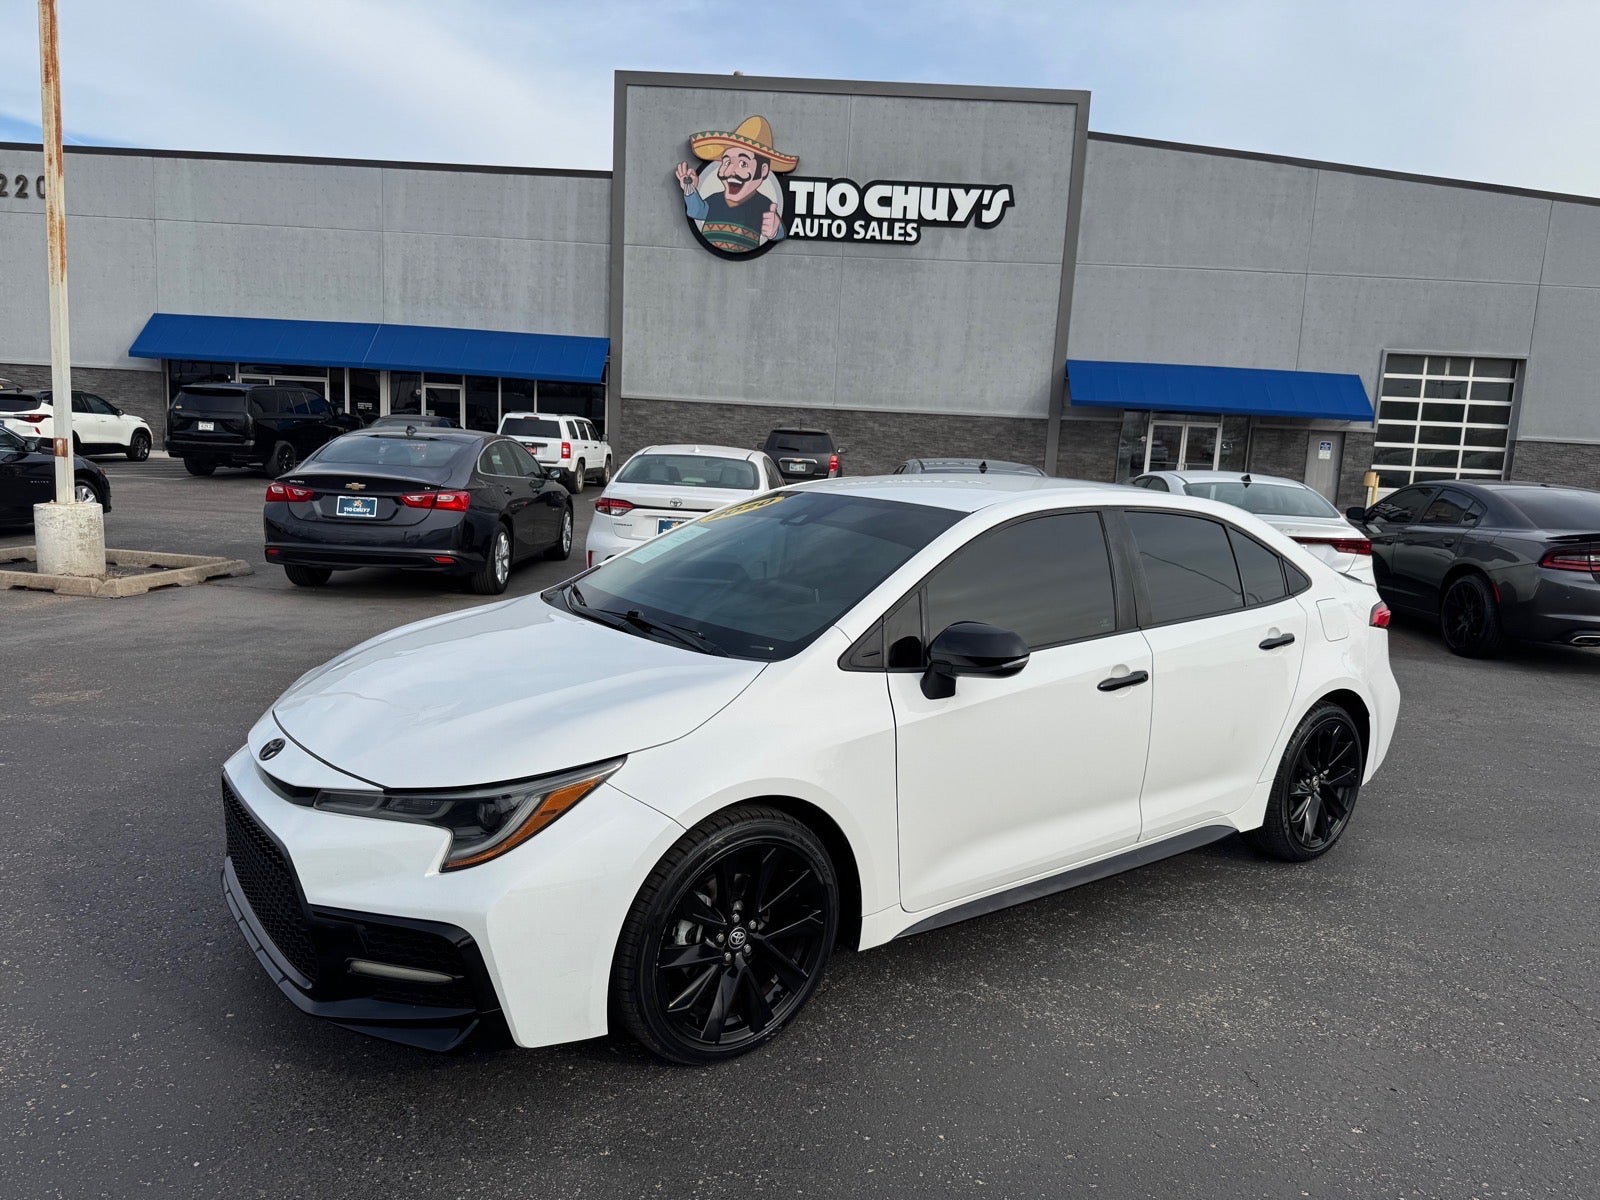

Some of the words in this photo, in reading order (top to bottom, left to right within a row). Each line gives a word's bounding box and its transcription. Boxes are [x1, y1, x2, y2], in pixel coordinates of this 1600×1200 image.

[789, 181, 859, 217] TIO
[864, 184, 1010, 223] CHUY'S
[789, 218, 847, 239] AUTO
[853, 220, 918, 242] SALES
